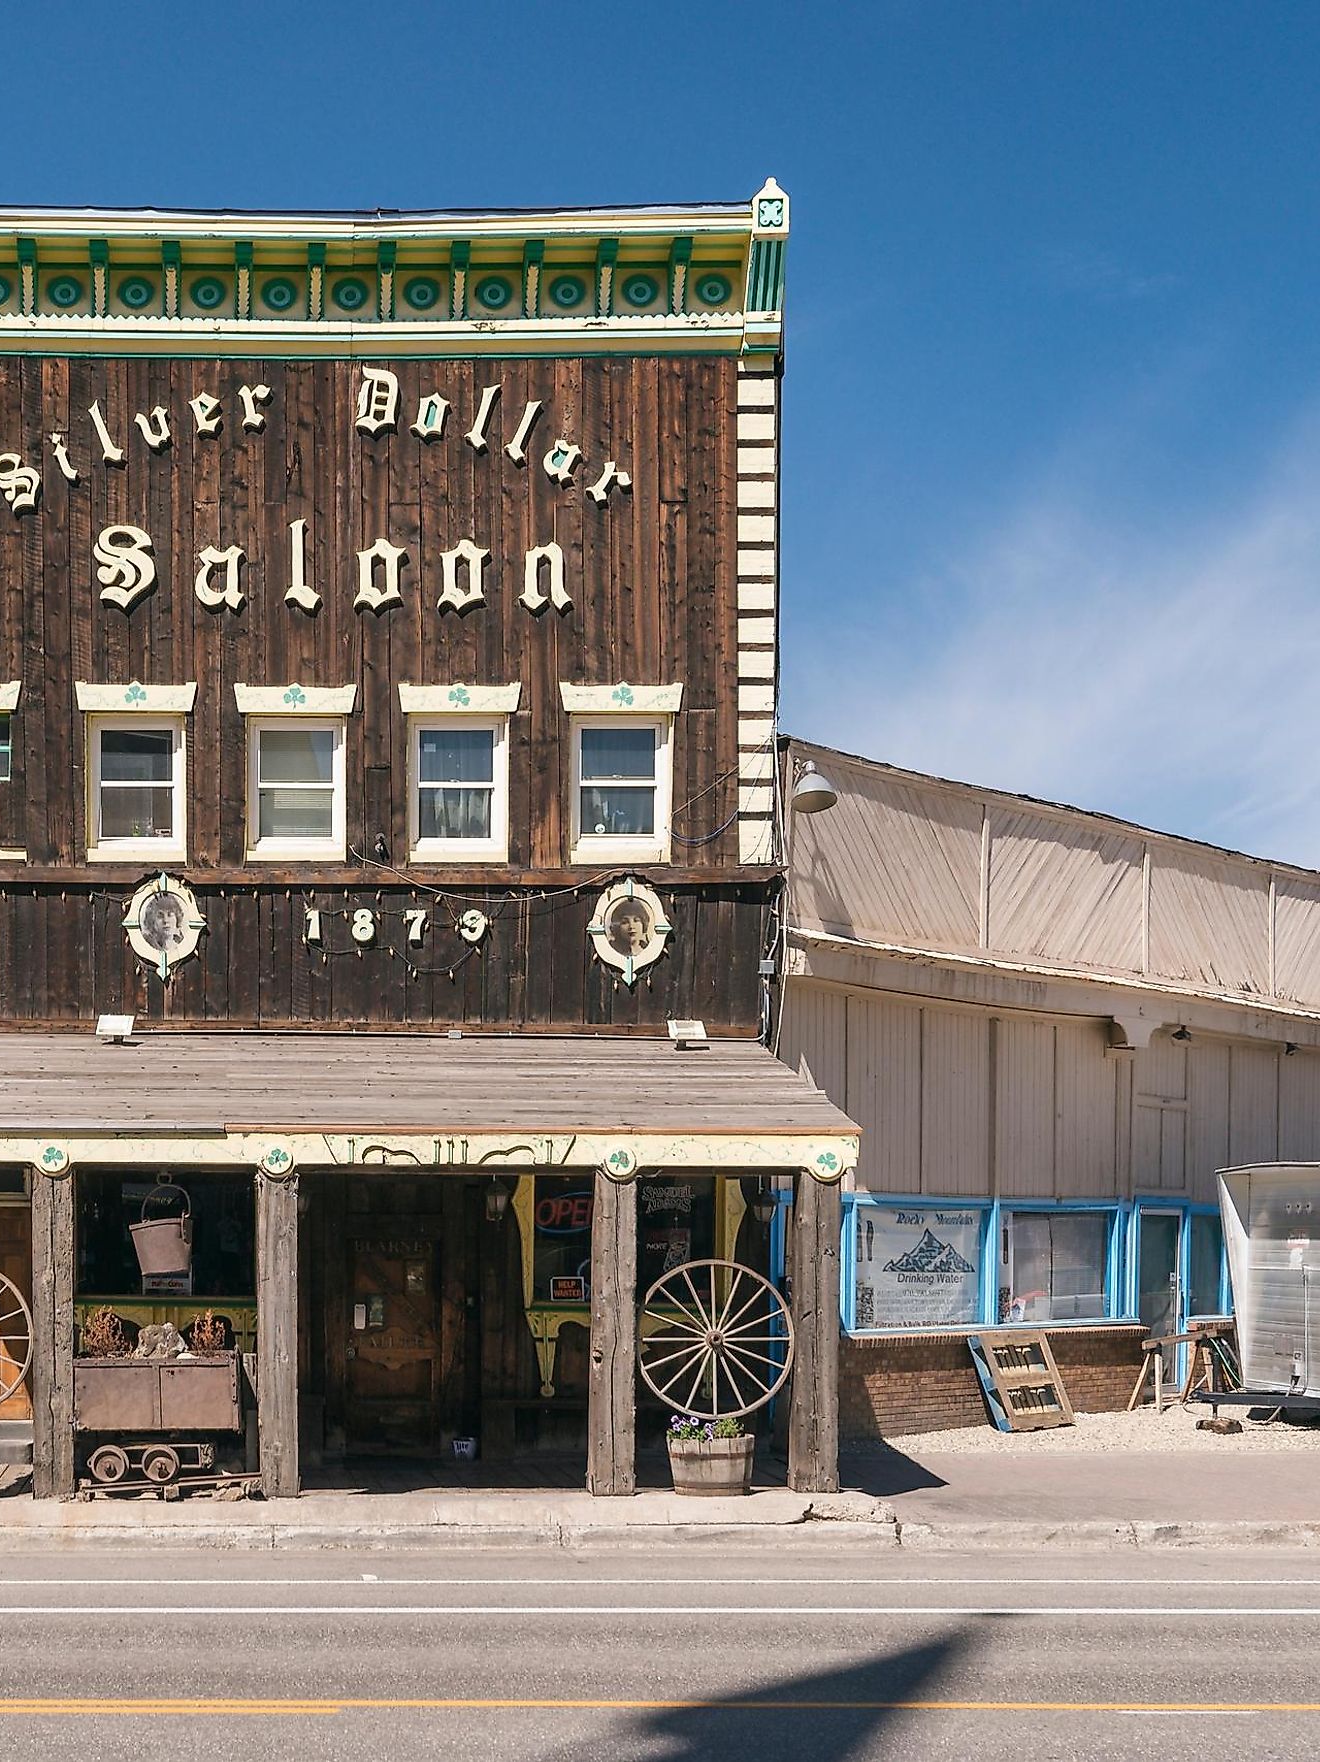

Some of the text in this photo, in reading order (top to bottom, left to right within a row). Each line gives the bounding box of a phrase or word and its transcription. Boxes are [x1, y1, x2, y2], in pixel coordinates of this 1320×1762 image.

[355, 366, 633, 506] Dollar
[95, 518, 574, 612] Saloon
[306, 908, 489, 945] 1879
[896, 1212, 924, 1224] Rocky
[558, 1281, 576, 1289] HELP
[897, 1273, 963, 1286] Drinking Water
[554, 1290, 582, 1298] WANTED
